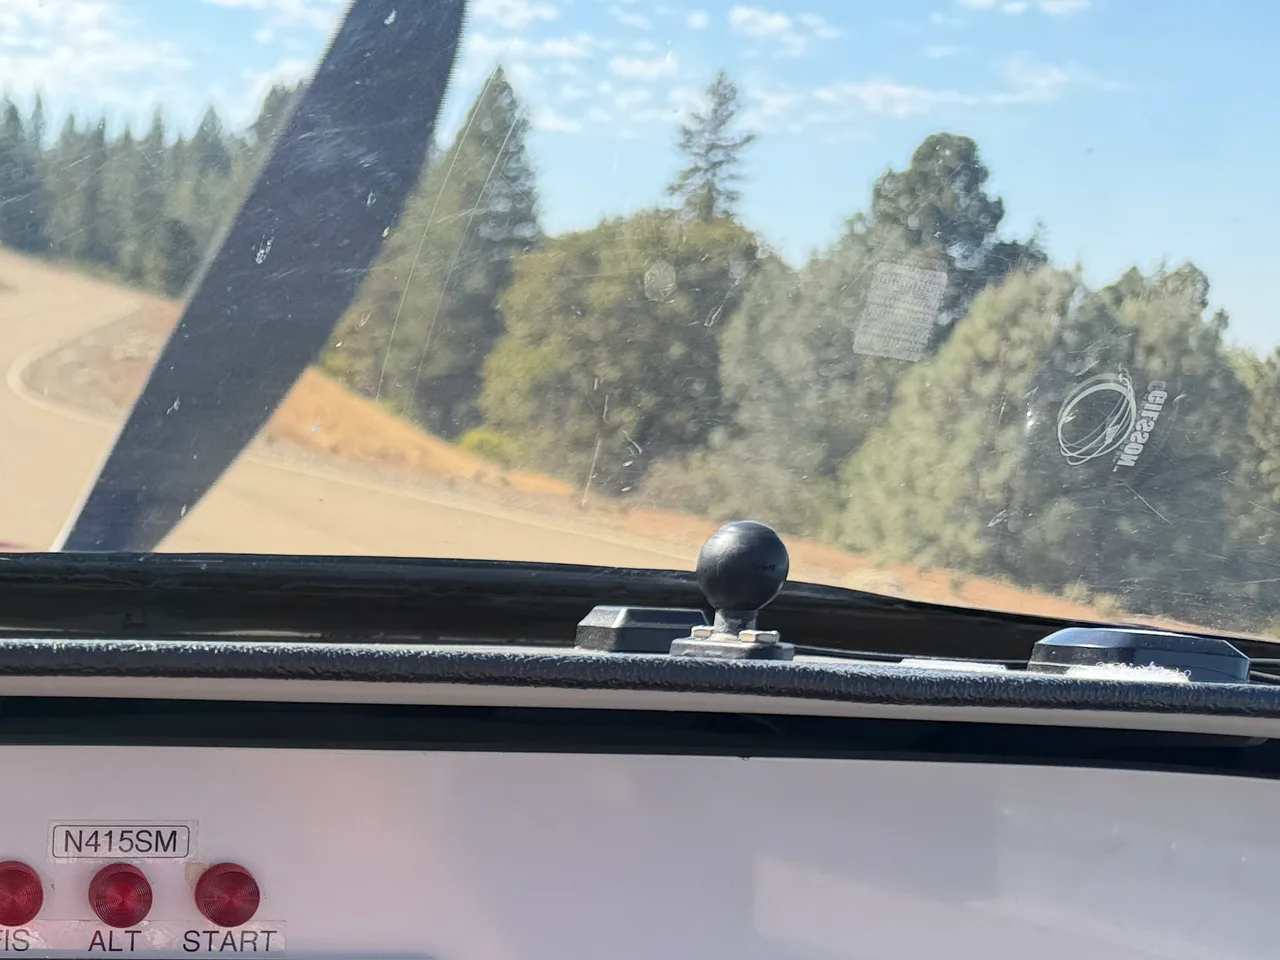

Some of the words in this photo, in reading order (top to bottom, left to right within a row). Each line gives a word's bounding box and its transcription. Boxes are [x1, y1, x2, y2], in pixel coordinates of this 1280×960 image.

[64, 830, 177, 853] N415SM
[88, 930, 141, 952] ALT
[183, 930, 278, 952] START
